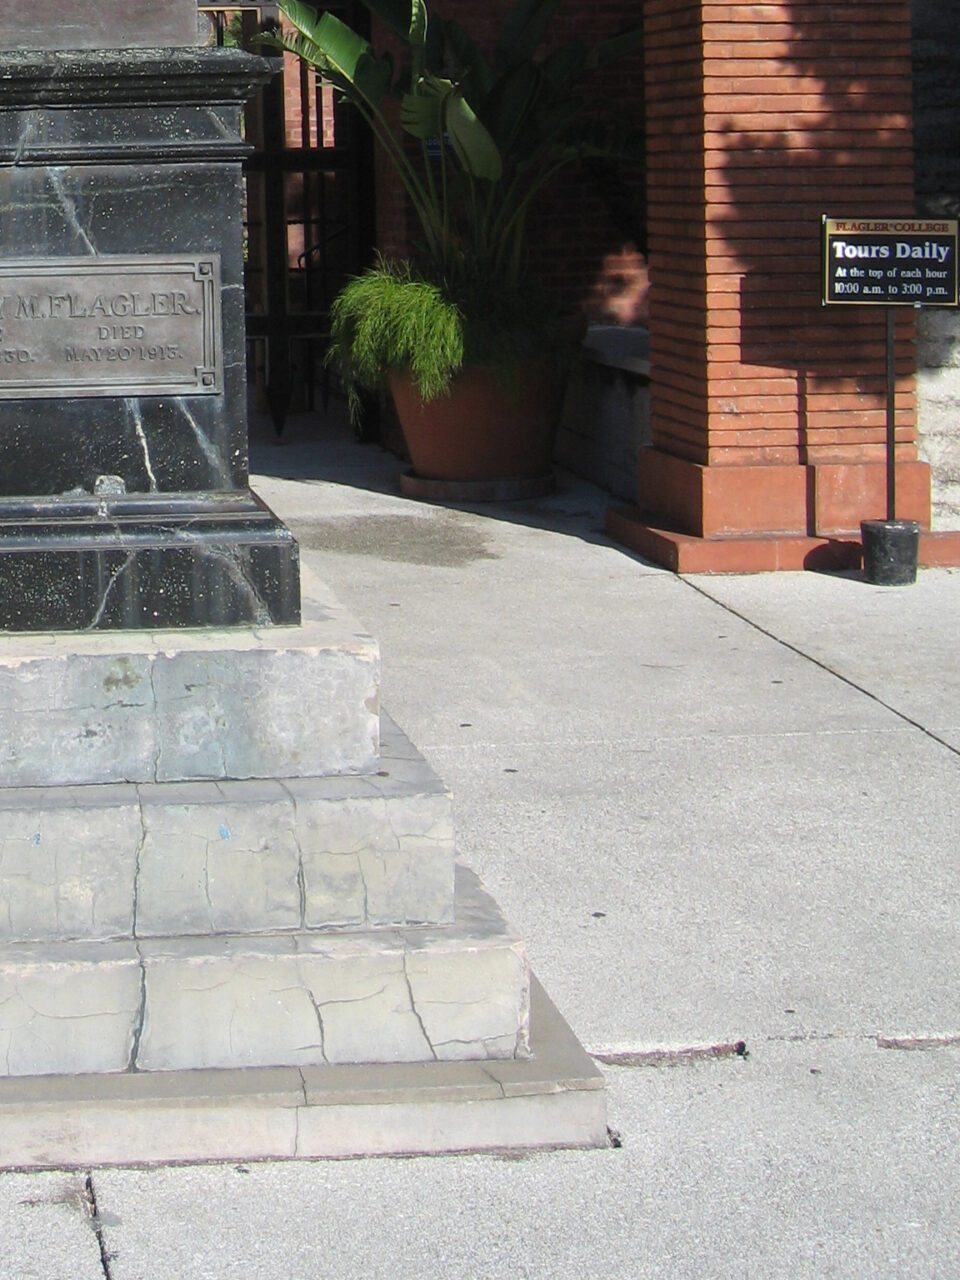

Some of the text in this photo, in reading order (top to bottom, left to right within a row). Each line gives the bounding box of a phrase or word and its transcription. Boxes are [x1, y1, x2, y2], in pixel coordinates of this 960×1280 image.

[835, 222, 949, 233] FLAGLER COLLEGE
[832, 241, 950, 263] Tours Daily
[834, 266, 948, 280] At the top of each hour
[834, 282, 949, 297] 10:00 a.m. to 3:00 p.m.
[97, 324, 146, 341] DIED
